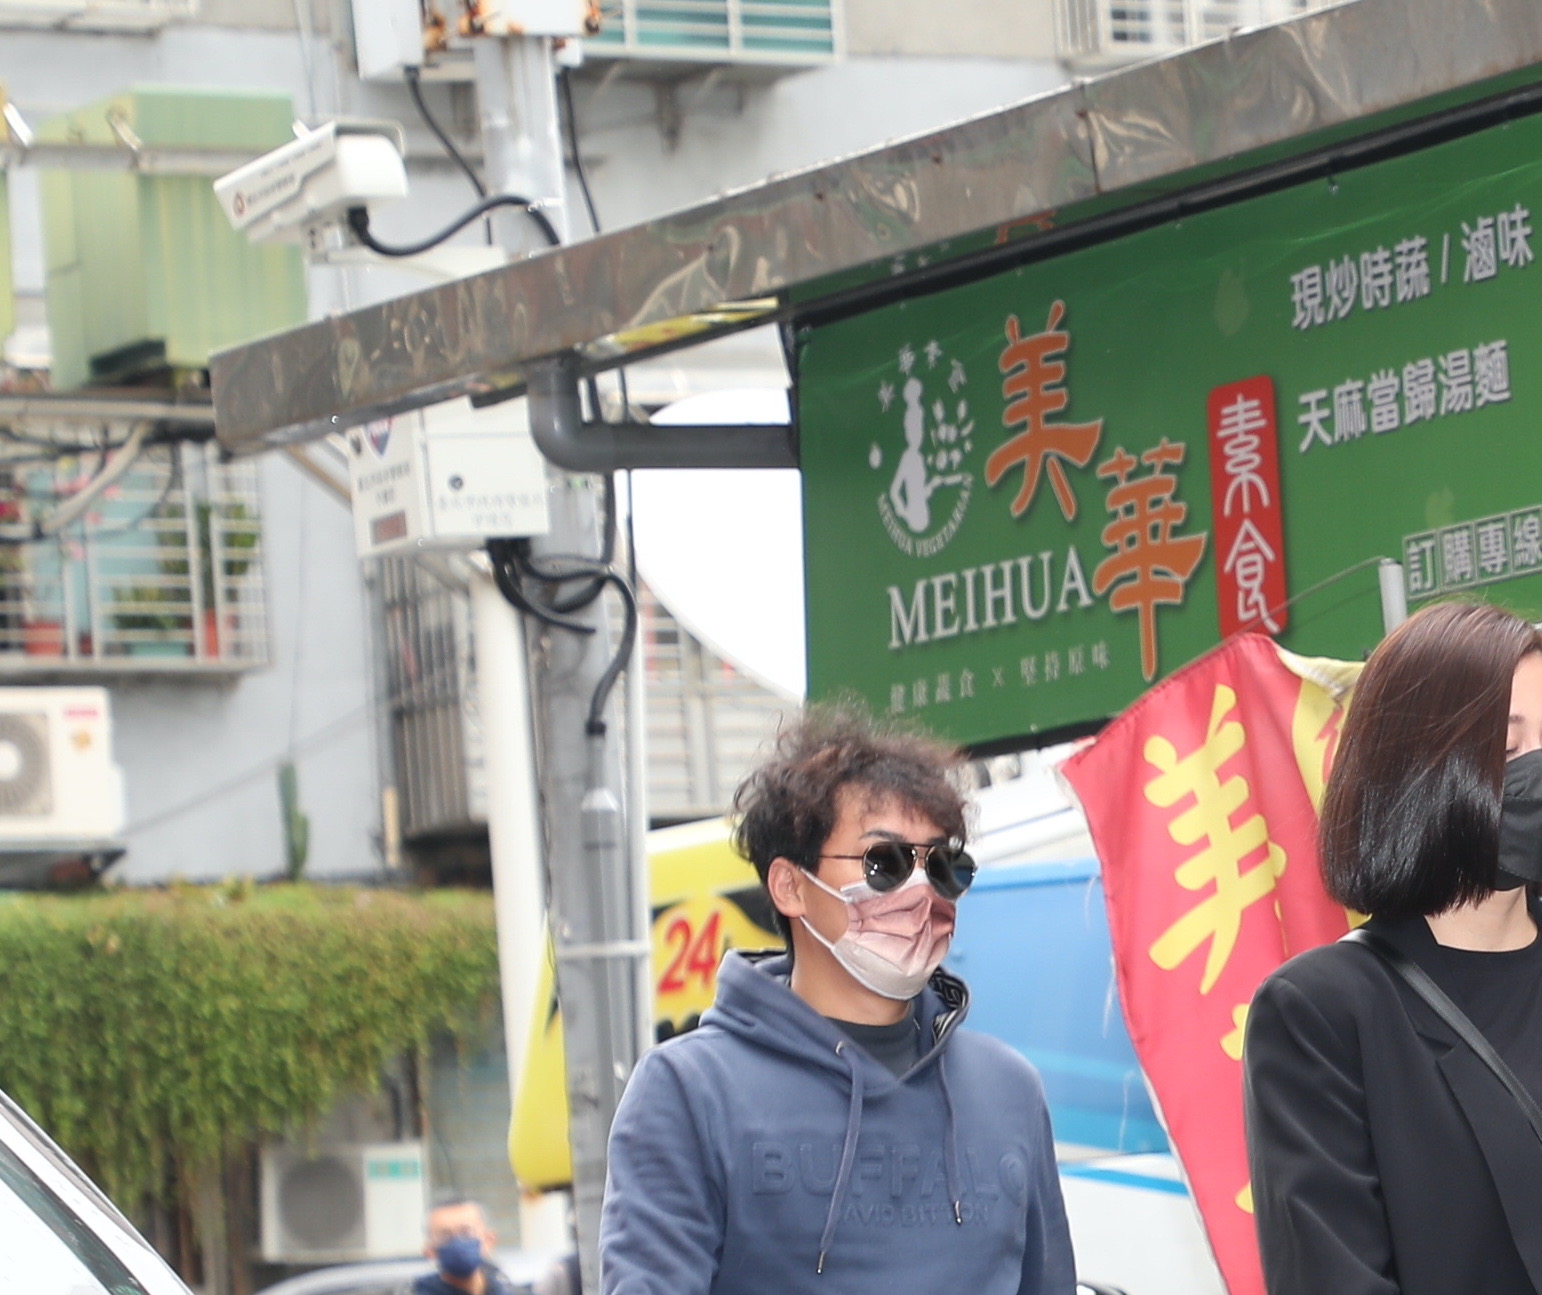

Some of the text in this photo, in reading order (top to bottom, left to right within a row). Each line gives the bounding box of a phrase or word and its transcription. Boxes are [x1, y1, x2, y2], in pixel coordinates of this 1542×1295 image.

[1298, 339, 1511, 454] 天麻當歸湯麵
[1215, 393, 1280, 634] 素食
[886, 545, 1095, 649] MEIHUA
[656, 910, 721, 995] 24
[826, 1202, 895, 1228] AVID
